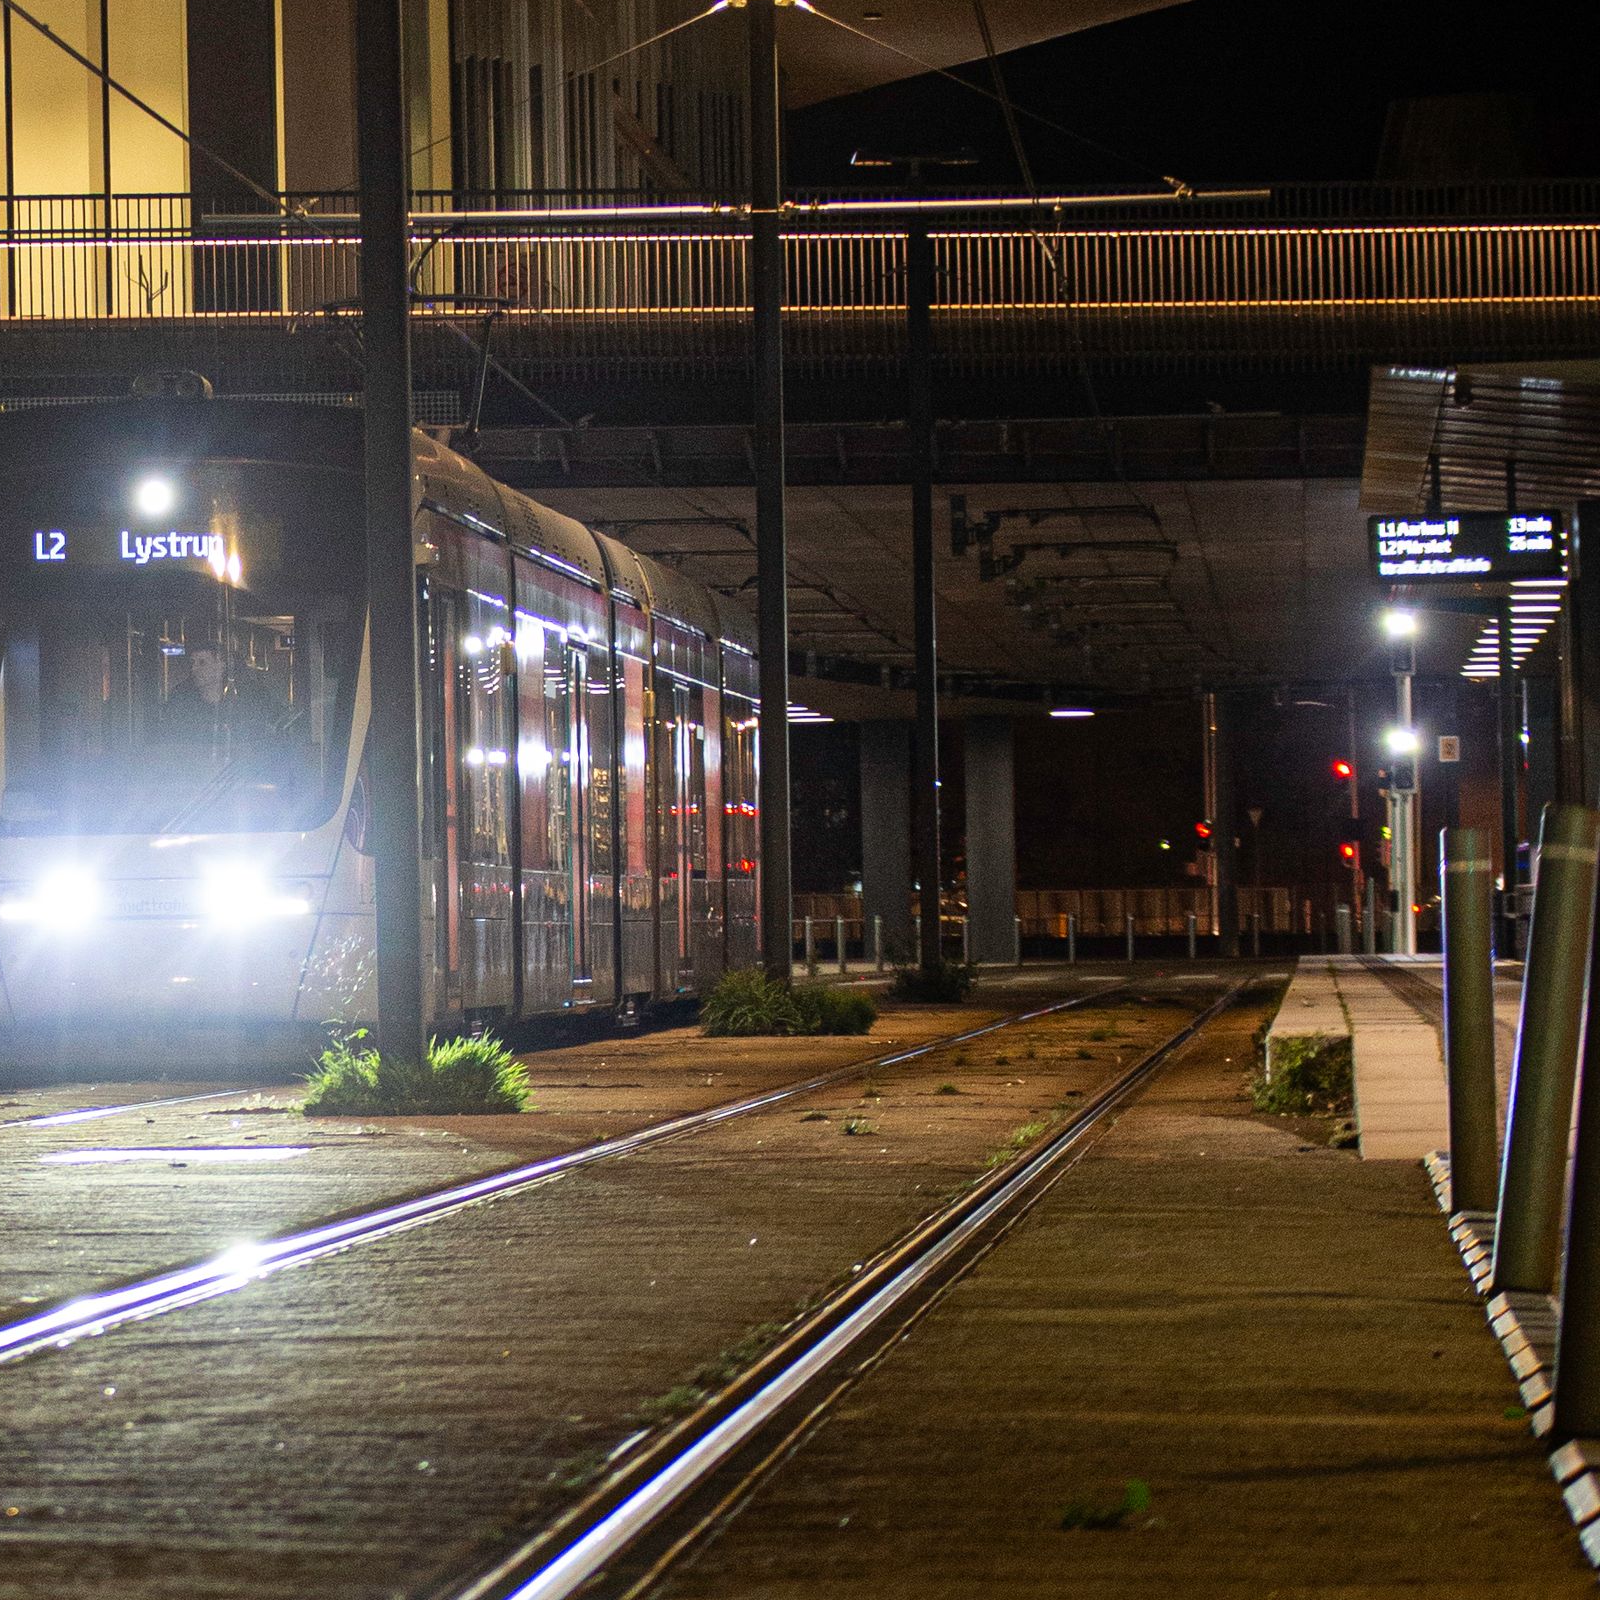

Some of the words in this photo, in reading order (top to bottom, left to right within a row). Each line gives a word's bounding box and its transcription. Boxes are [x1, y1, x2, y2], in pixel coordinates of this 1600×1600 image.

[36, 532, 66, 560] L2
[121, 531, 225, 564] Lystrup
[1379, 541, 1397, 555] L2
